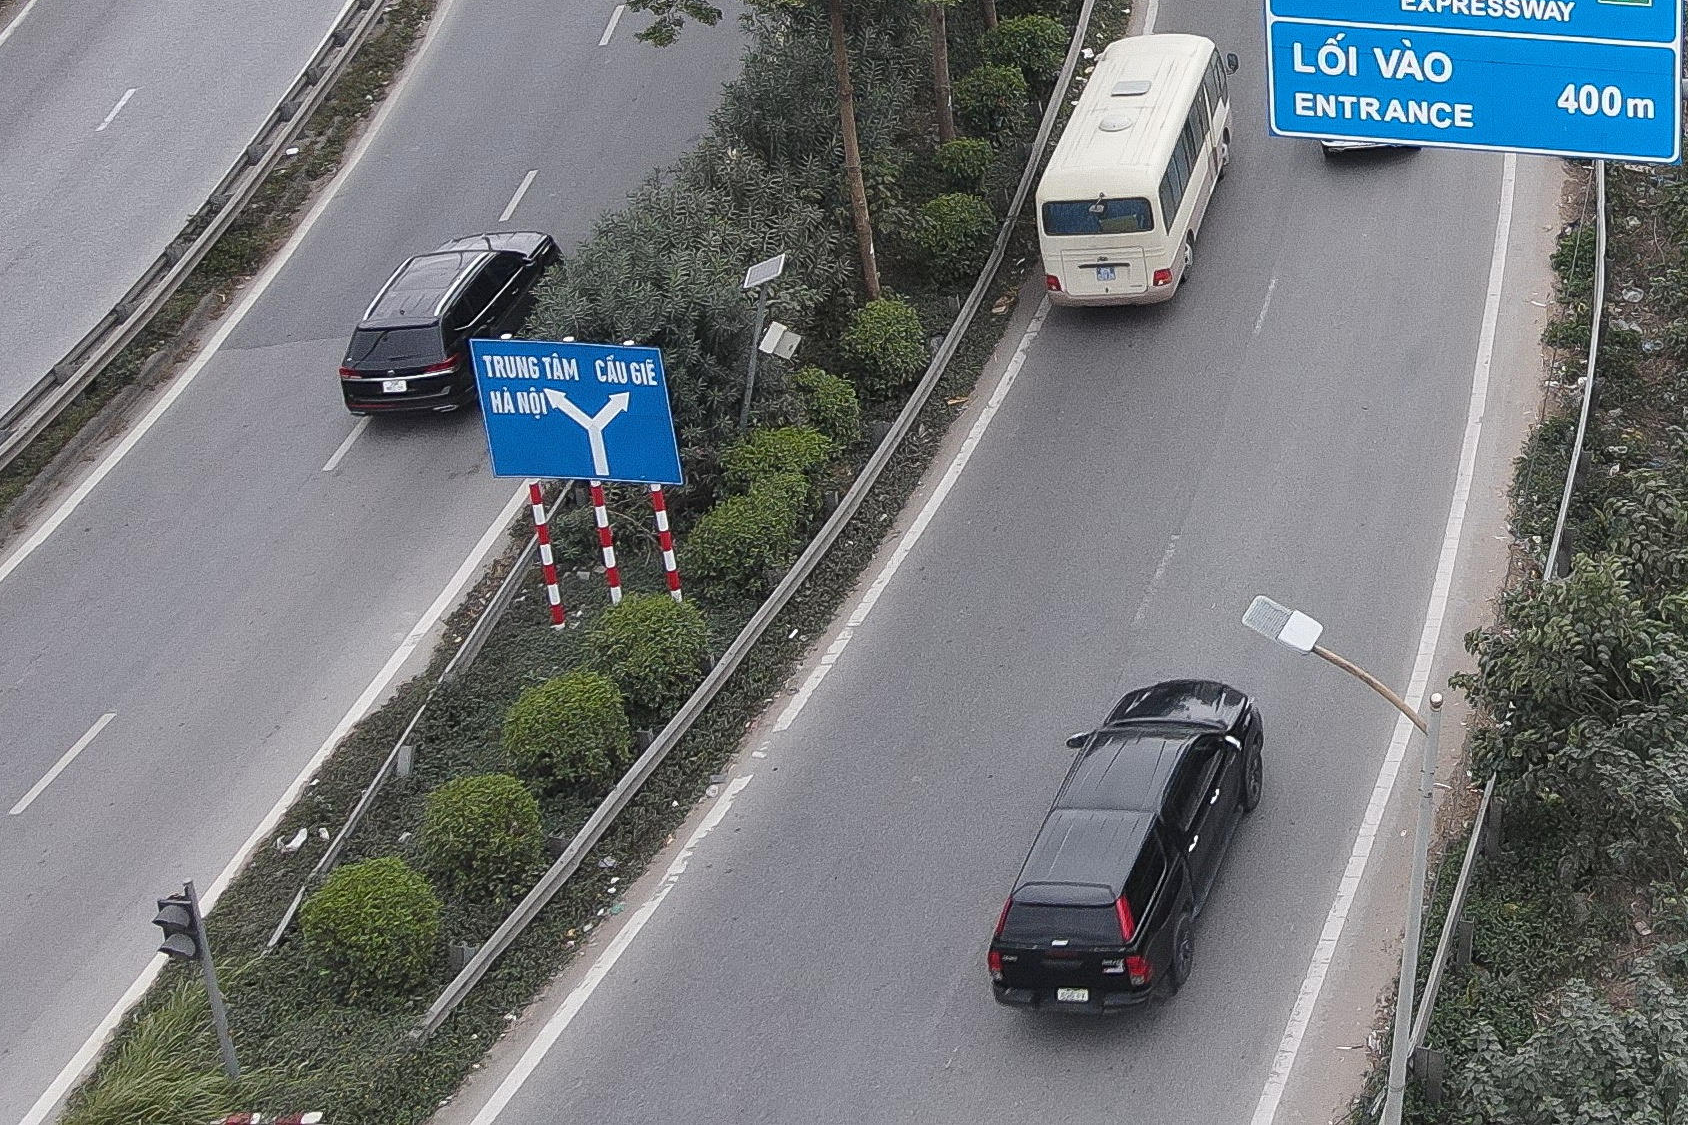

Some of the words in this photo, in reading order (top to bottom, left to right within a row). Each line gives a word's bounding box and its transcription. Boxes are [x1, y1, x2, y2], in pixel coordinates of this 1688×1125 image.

[1292, 32, 1357, 77] LỐI
[1373, 39, 1453, 83] VÀO
[1294, 92, 1474, 129] ENTRANCE
[482, 355, 540, 380] TRUNG
[542, 353, 580, 381] TÂM
[629, 359, 659, 387] GIẼ
[516, 386, 549, 420] NỘI
